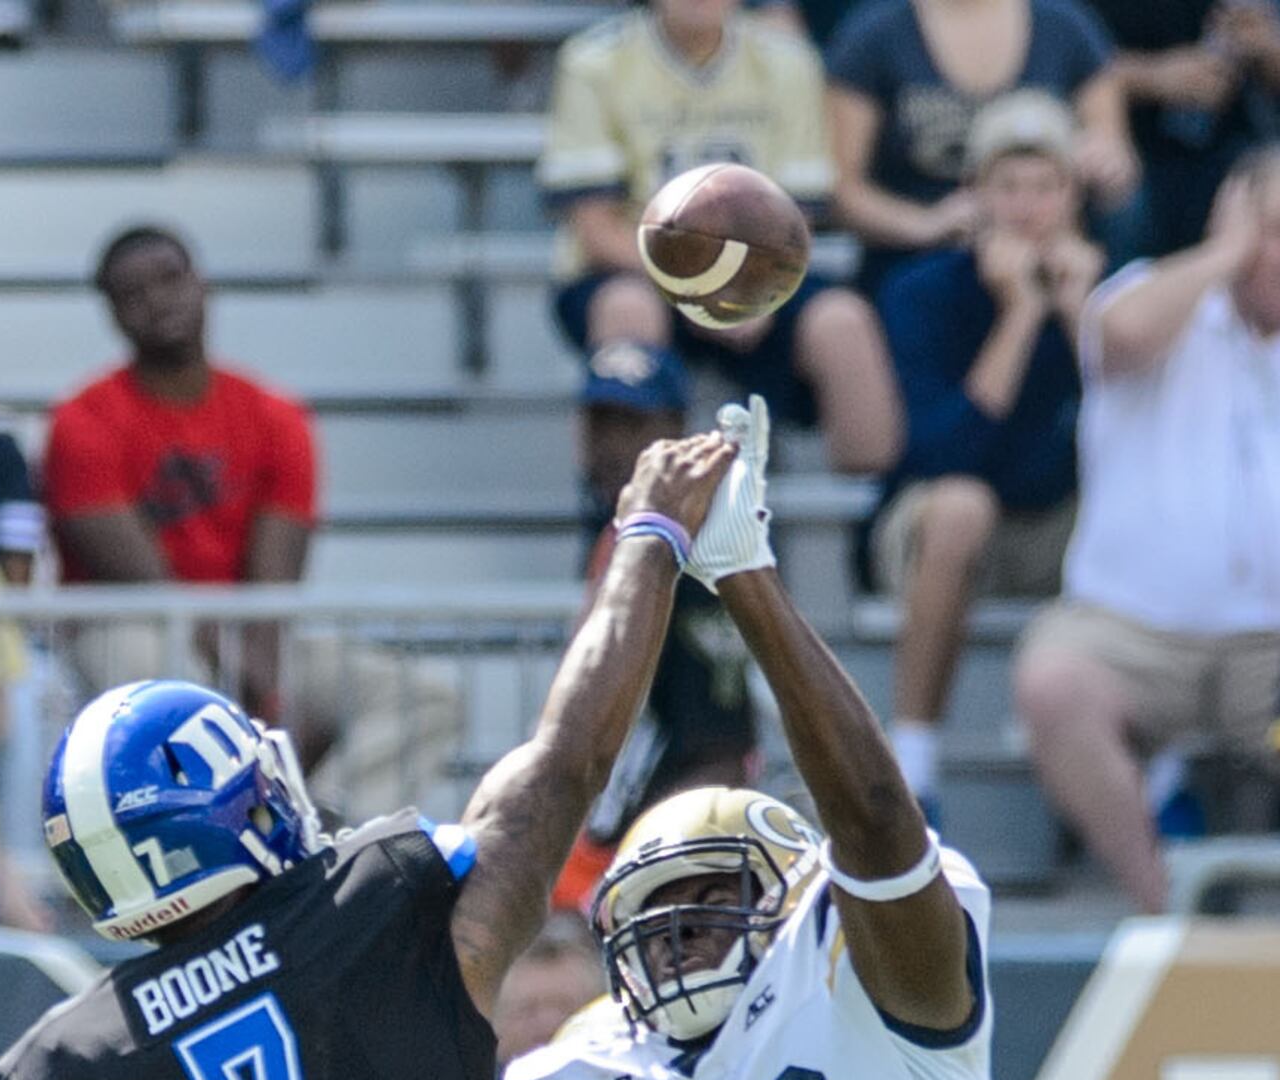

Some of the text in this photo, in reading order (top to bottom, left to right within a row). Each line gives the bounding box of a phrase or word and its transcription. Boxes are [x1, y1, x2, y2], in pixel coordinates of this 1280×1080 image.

[116, 784, 160, 814] ACC
[131, 836, 171, 888] 7
[131, 923, 280, 1036] BOONE
